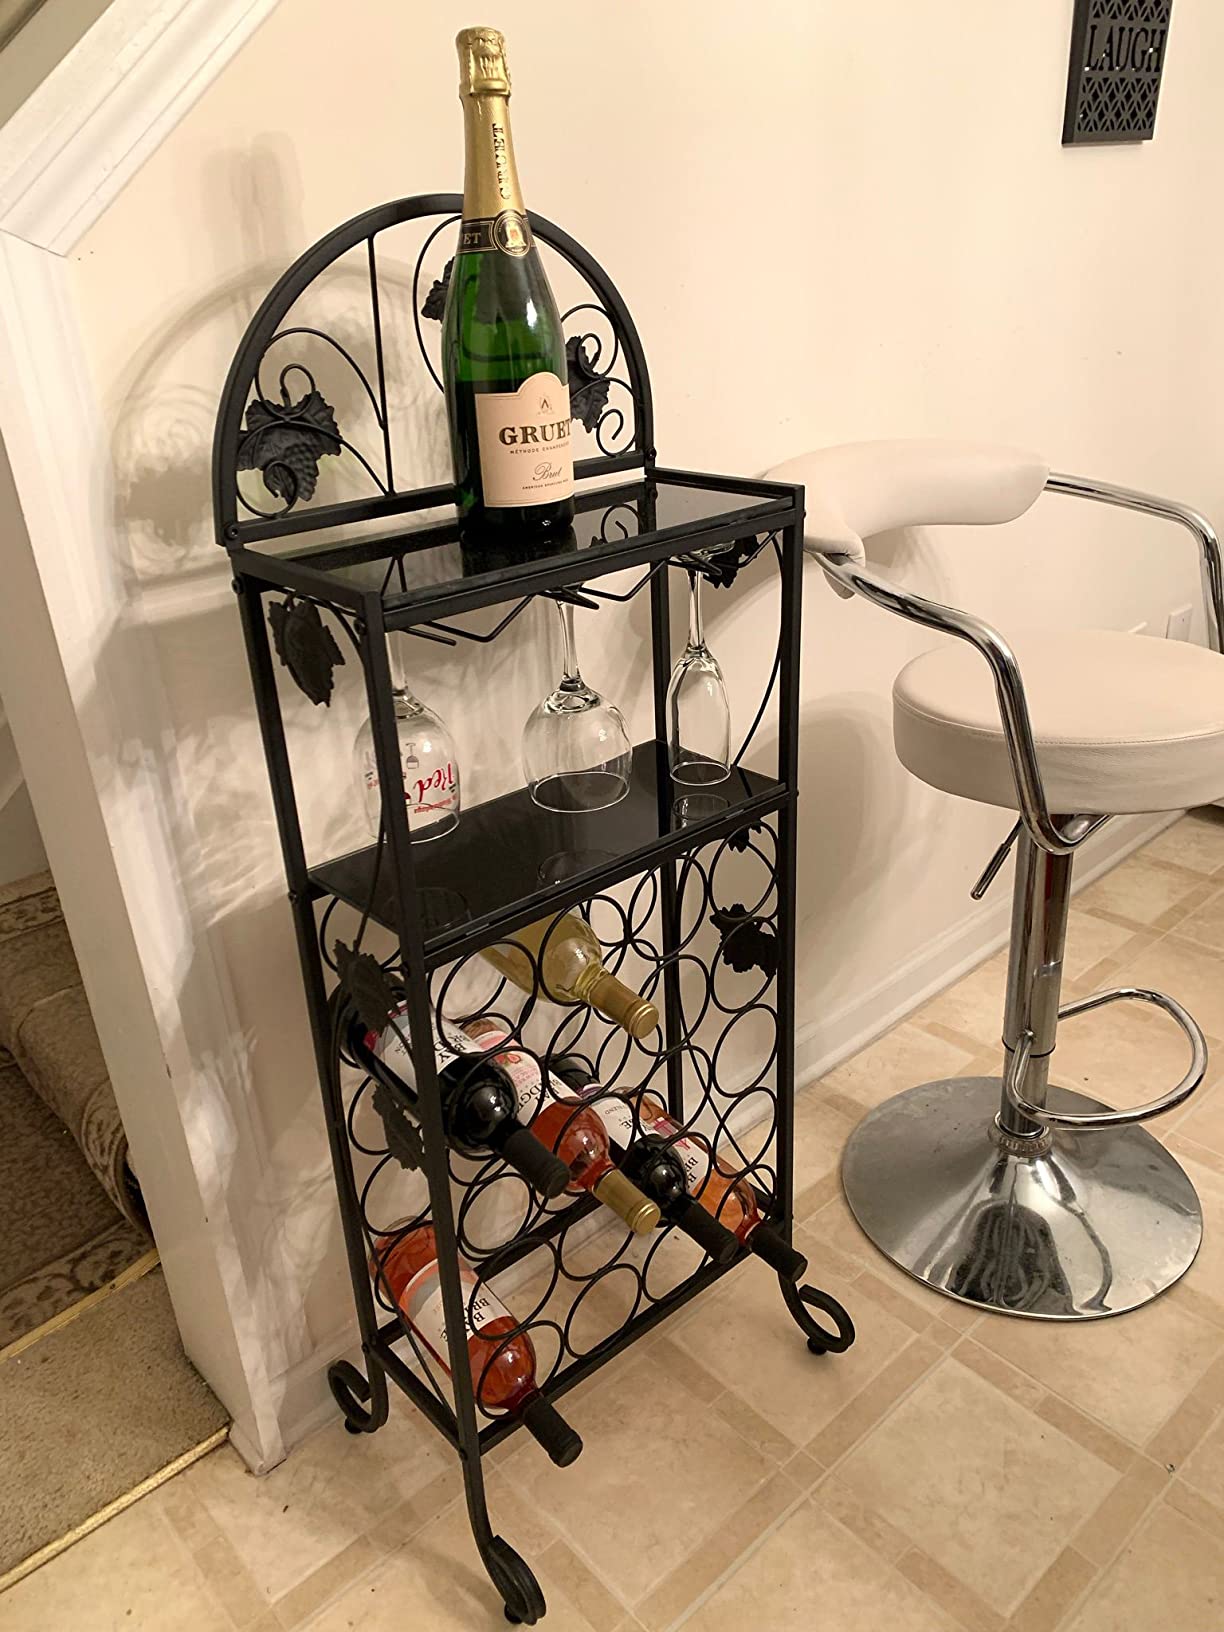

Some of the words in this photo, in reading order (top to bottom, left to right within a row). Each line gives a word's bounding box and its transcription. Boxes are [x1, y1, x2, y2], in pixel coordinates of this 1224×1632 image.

[1085, 25, 1166, 72] LAUGH
[532, 462, 562, 481] Brut
[413, 763, 453, 803] Red
